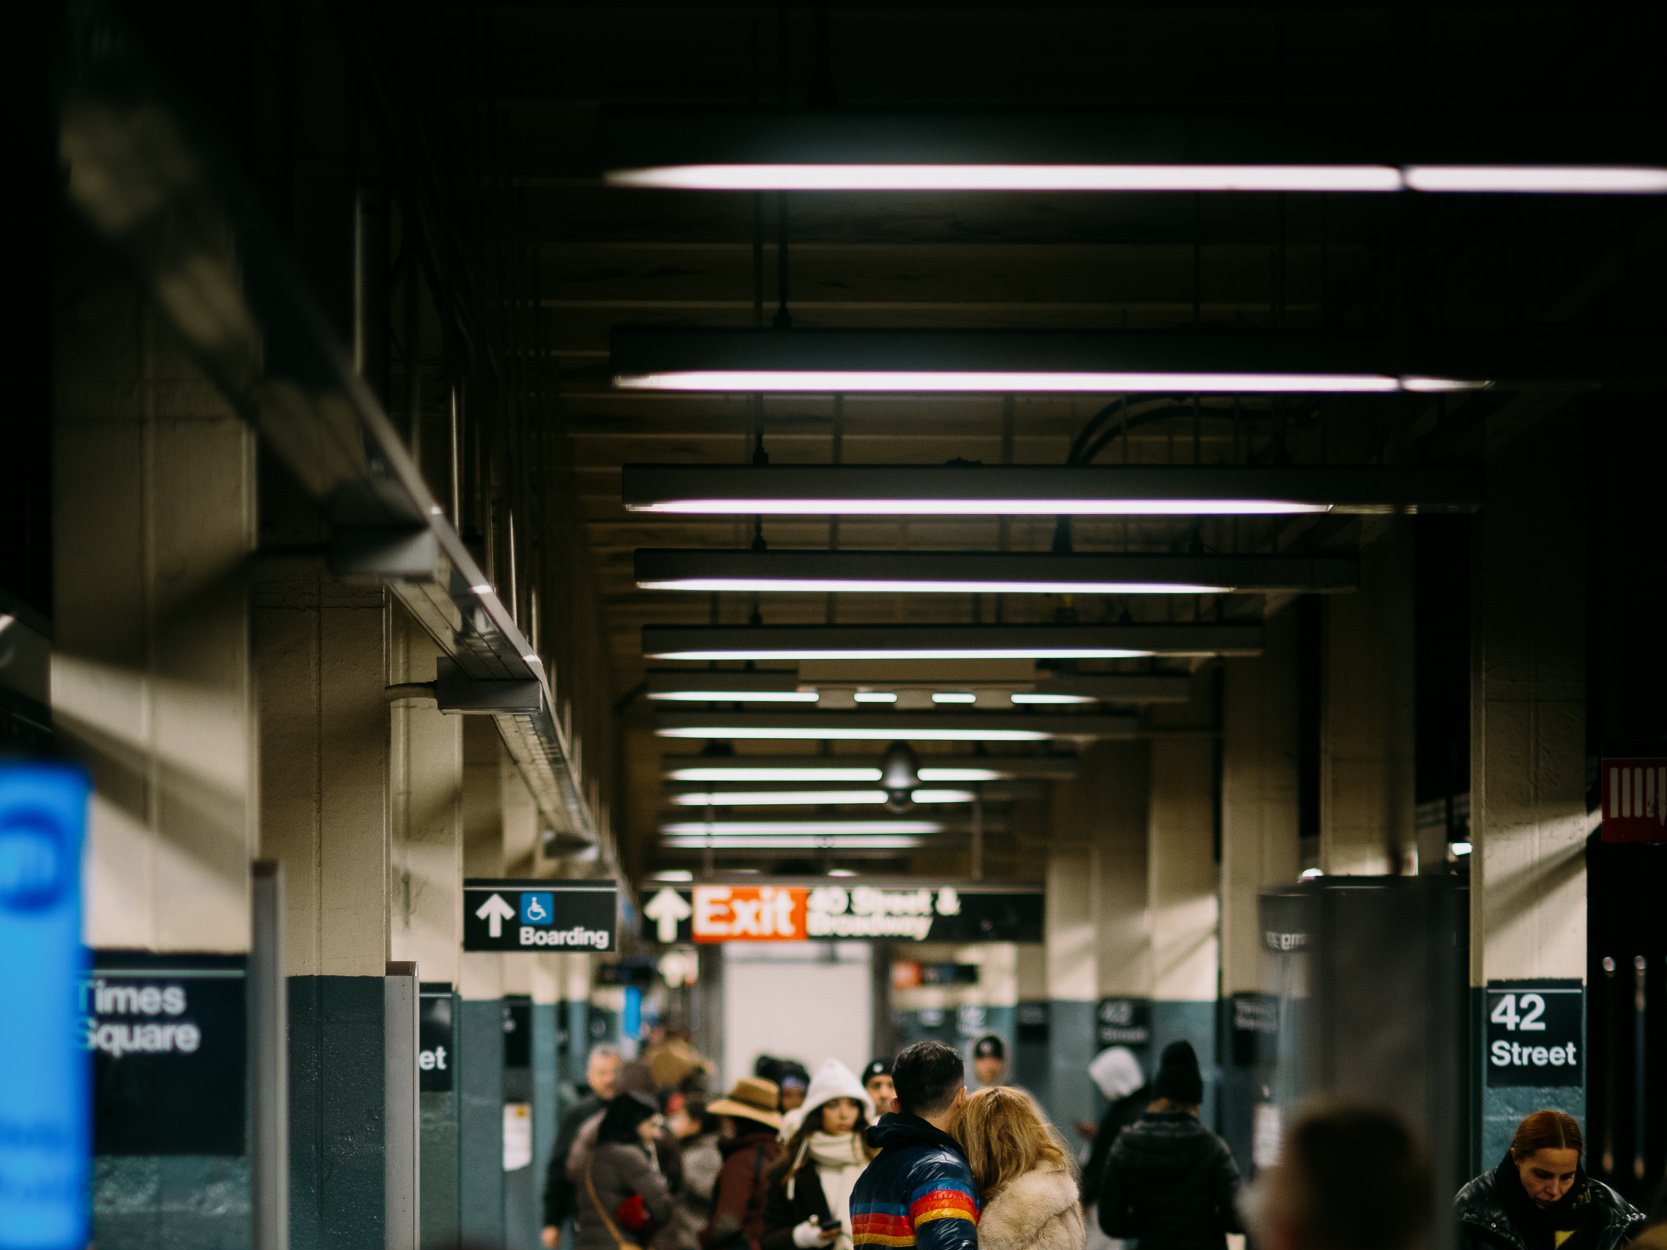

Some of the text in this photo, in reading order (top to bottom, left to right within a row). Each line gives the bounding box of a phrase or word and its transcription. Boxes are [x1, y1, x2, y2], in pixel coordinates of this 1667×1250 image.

[694, 886, 796, 936] Exit
[519, 926, 610, 950] Boarding
[1490, 993, 1546, 1031] 42
[1490, 1039, 1577, 1067] Street
